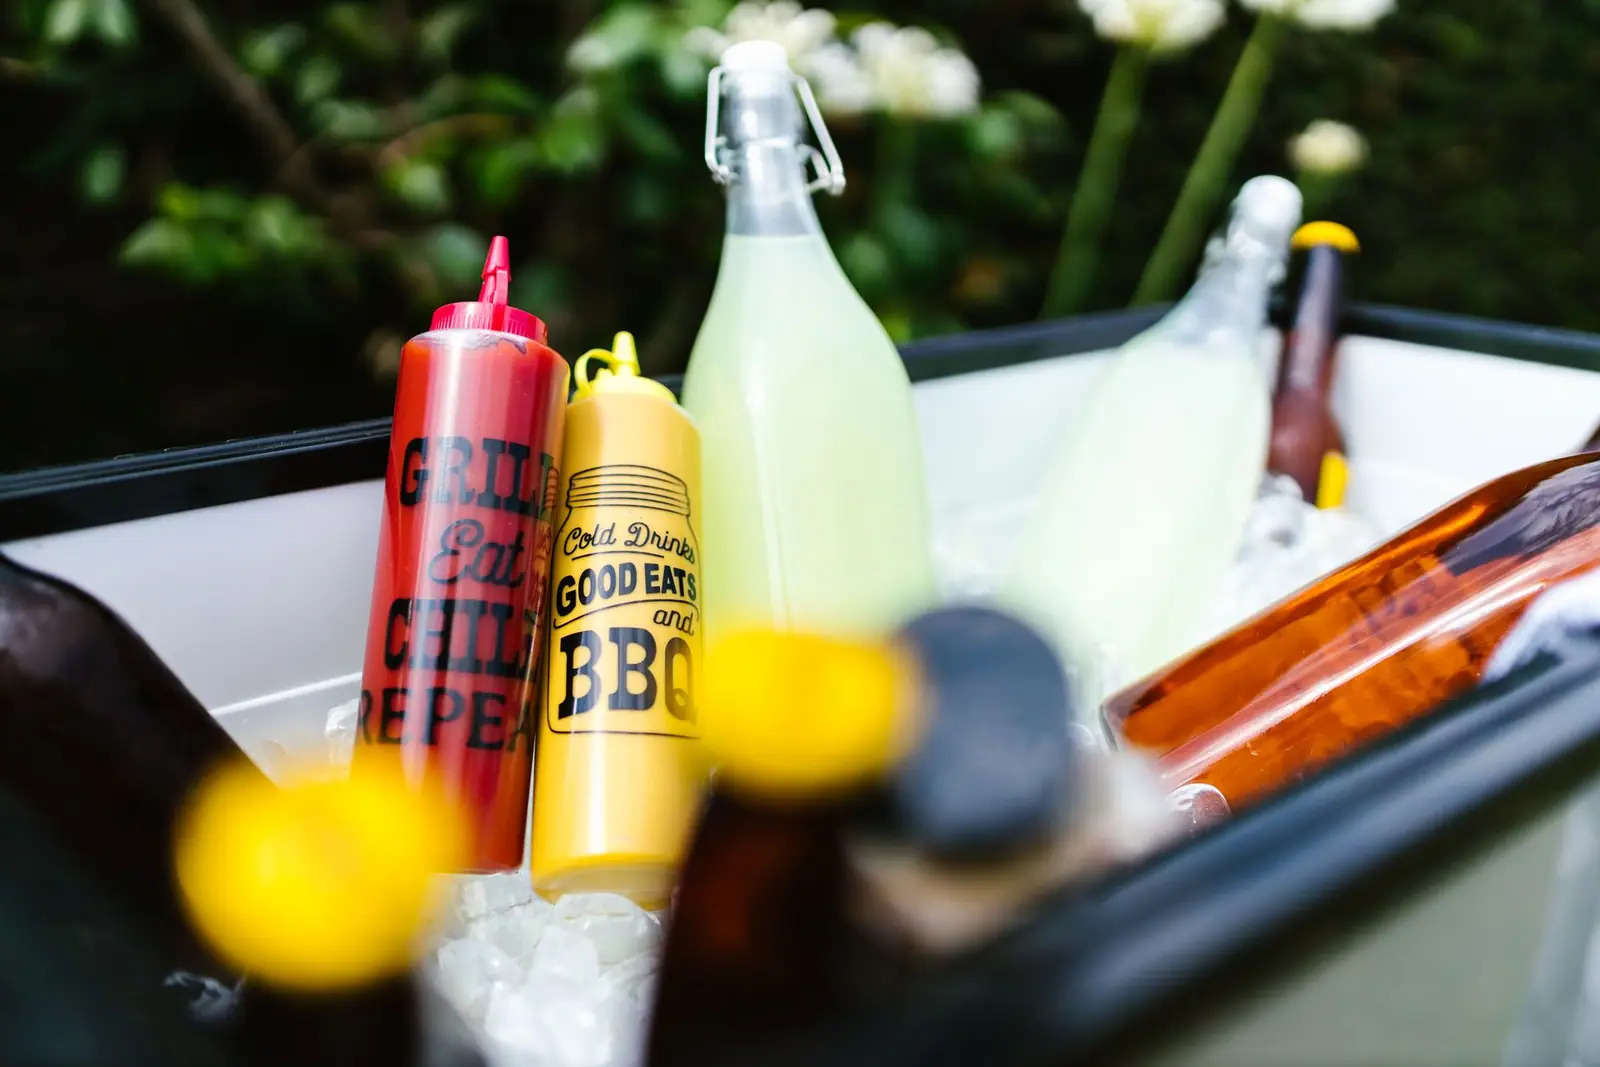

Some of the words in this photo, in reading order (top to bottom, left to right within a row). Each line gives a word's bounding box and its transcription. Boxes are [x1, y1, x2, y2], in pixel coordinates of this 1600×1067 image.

[427, 518, 525, 589] Eat
[564, 522, 617, 556] Cold
[624, 522, 696, 565] Drinks
[556, 562, 637, 617] GOOD
[644, 562, 697, 602] EATS
[653, 607, 695, 636] and
[558, 627, 697, 726] BBQ
